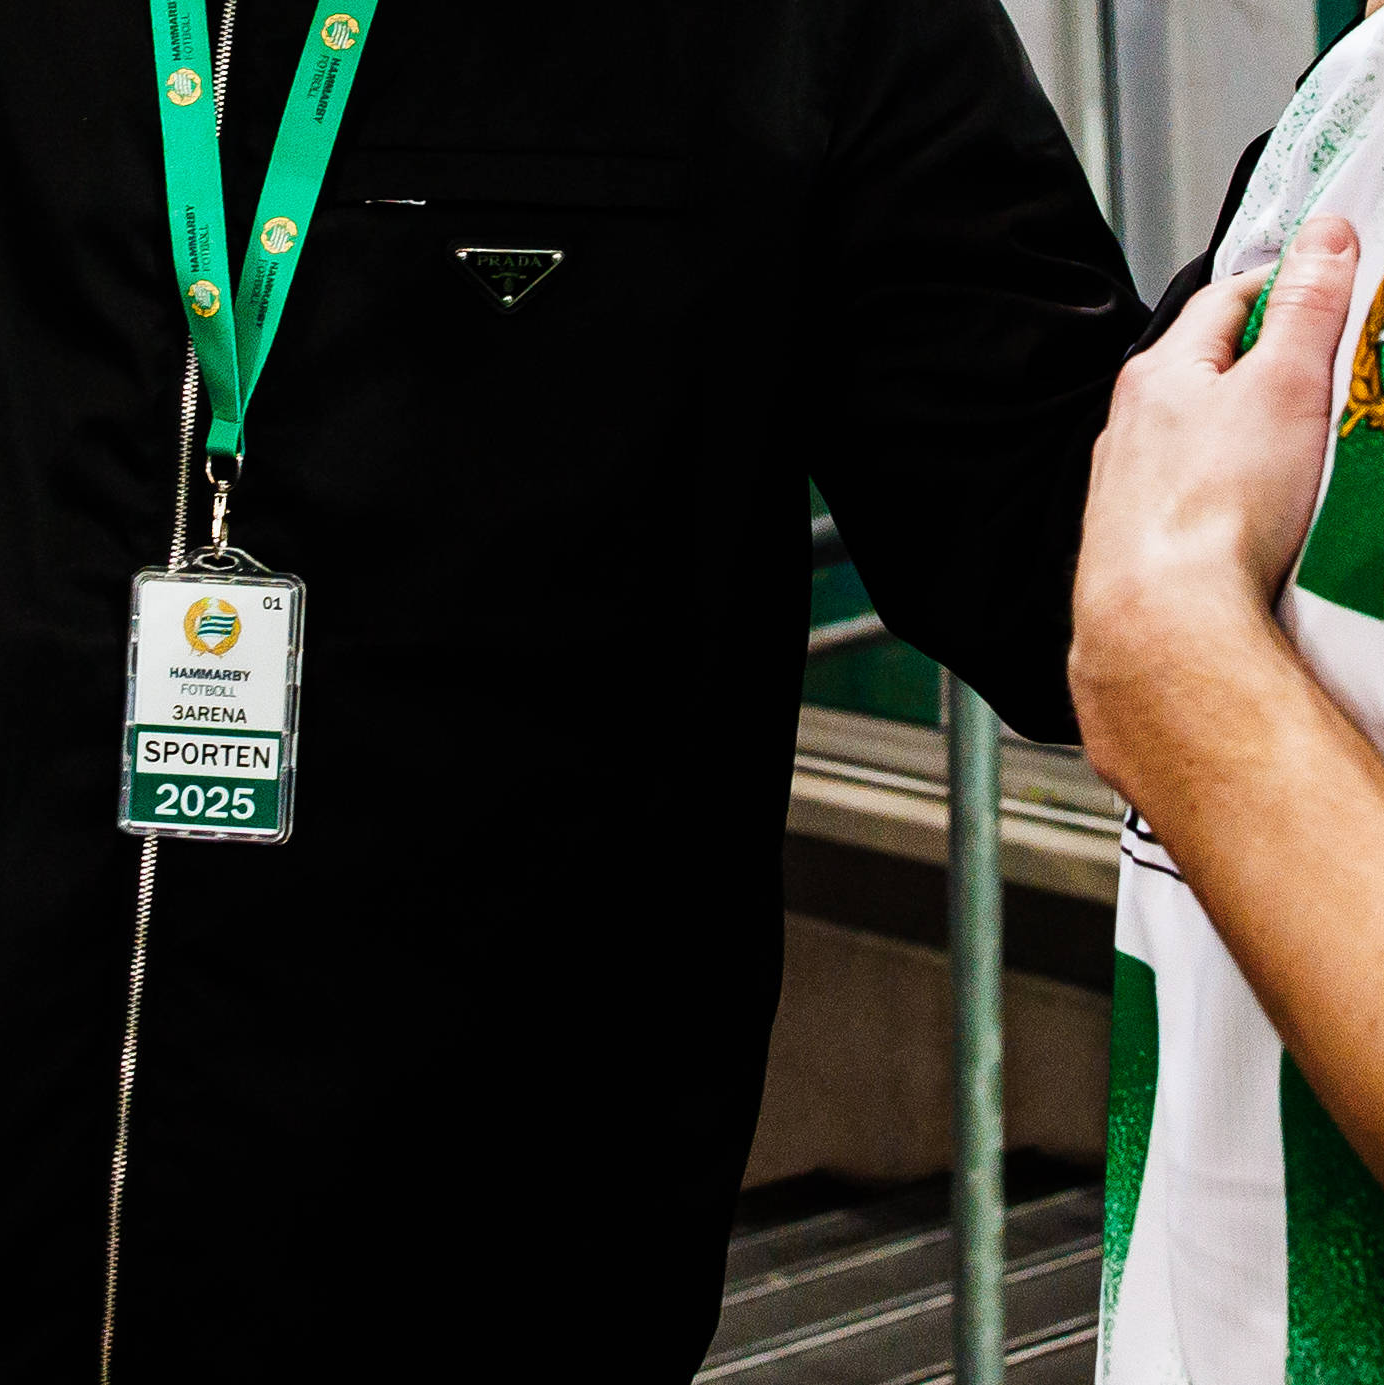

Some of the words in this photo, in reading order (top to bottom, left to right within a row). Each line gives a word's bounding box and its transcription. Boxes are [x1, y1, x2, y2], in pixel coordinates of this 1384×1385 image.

[313, 56, 342, 124] HAMMARBY
[476, 255, 542, 267] PRADA
[263, 596, 283, 611] 01
[169, 667, 251, 682] HAMMARBY
[181, 683, 236, 697] FOTBOLL
[172, 704, 247, 724] 3ARENA
[144, 740, 271, 769] SPORTEN
[155, 783, 255, 820] 2025
